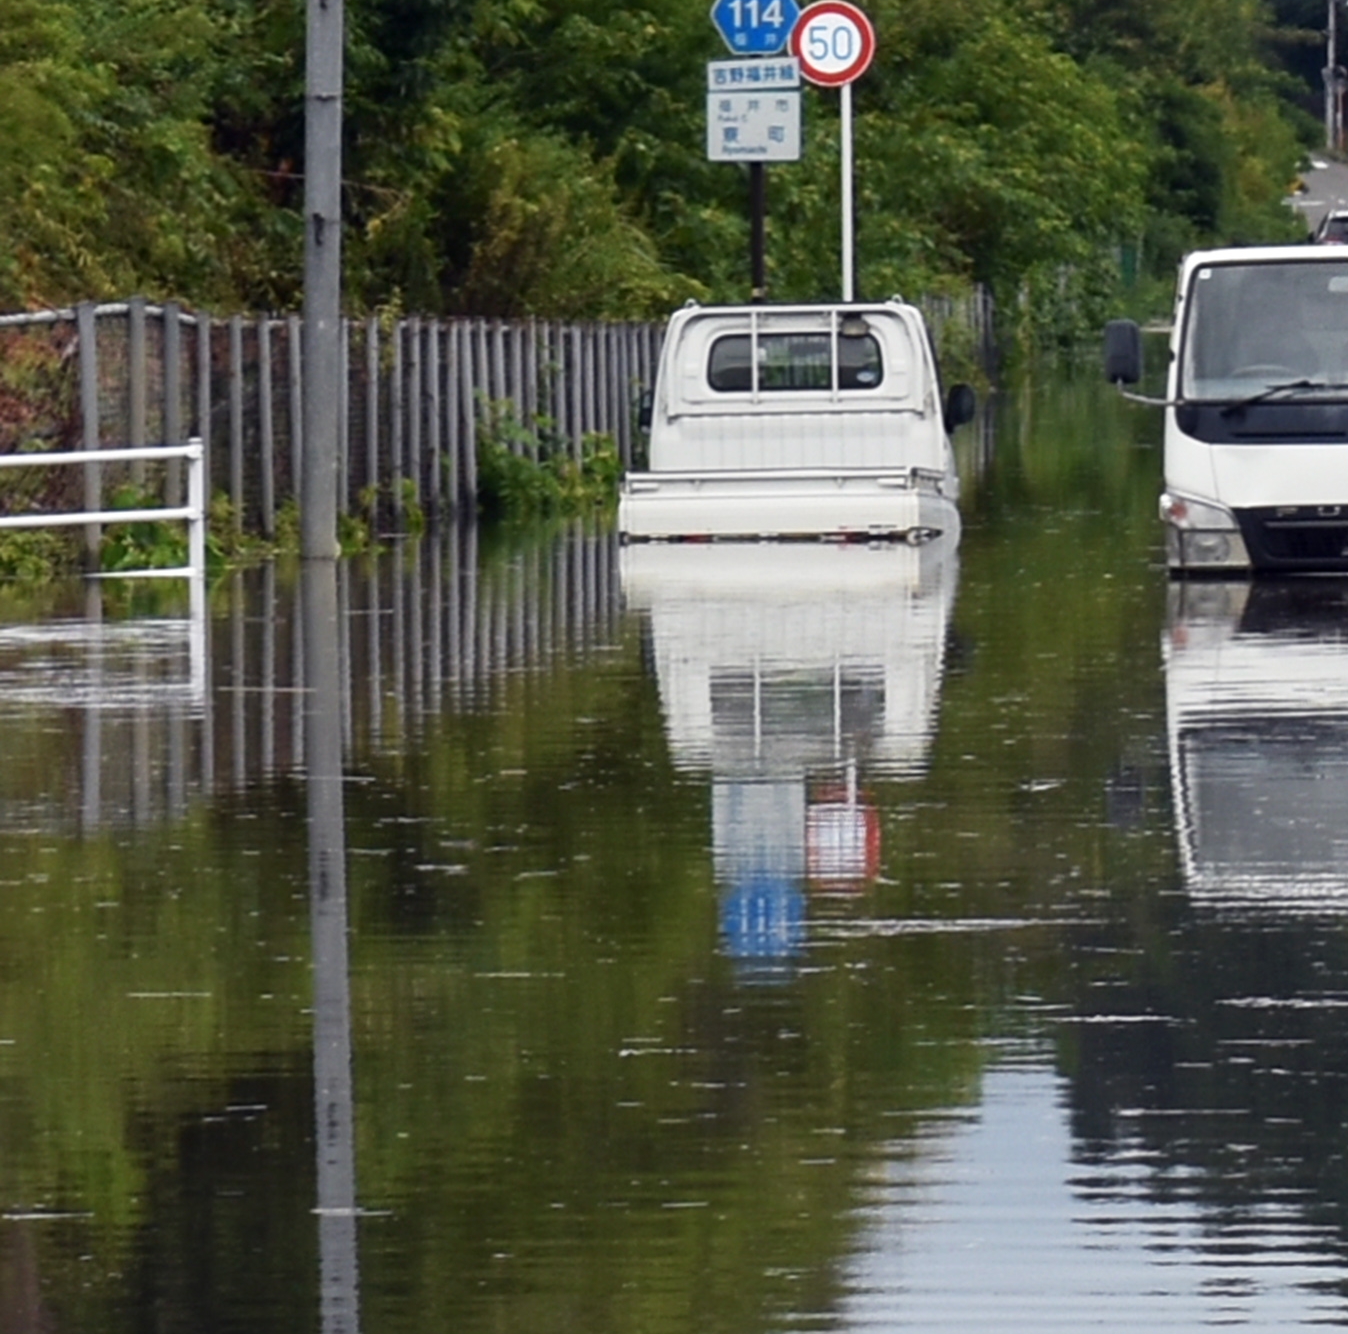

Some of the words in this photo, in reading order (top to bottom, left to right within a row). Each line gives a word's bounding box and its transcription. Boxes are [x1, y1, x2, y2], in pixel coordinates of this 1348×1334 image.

[809, 26, 853, 61] 50
[712, 65, 795, 85] 吉野福井線
